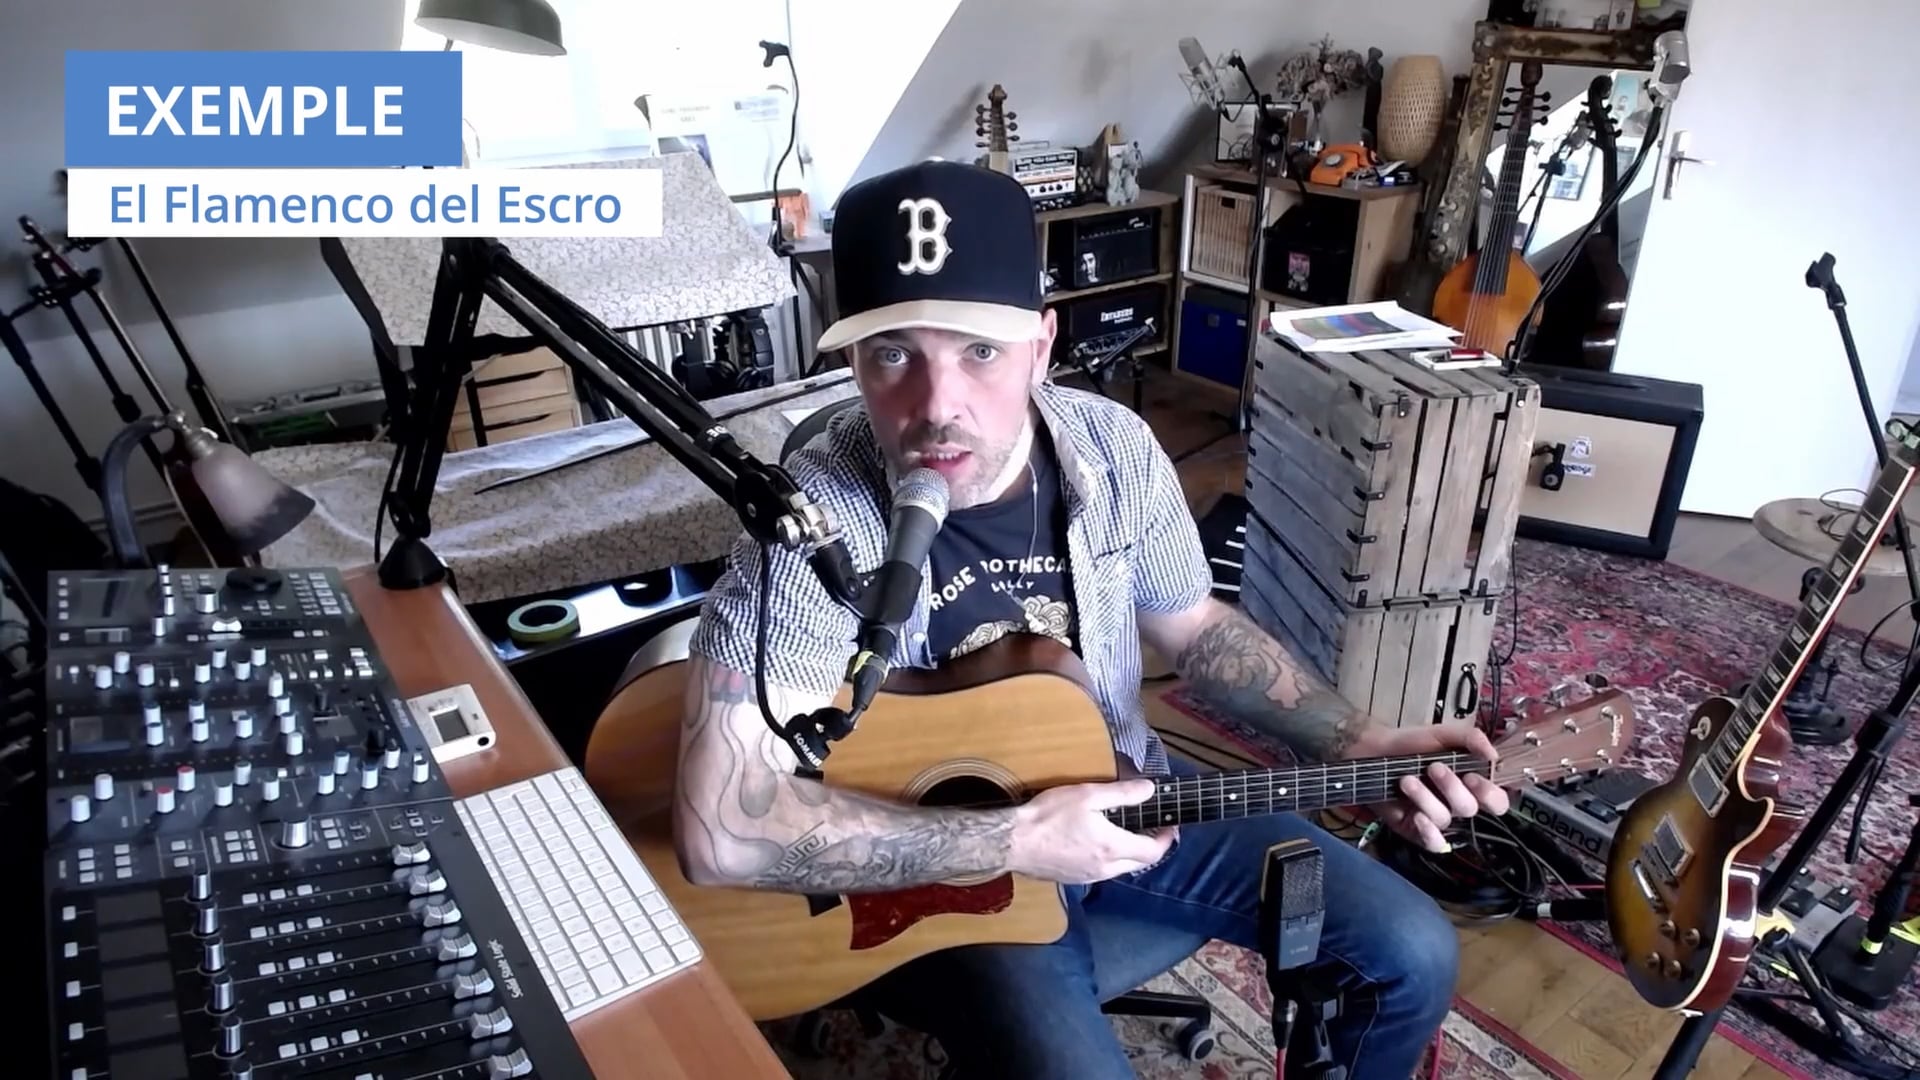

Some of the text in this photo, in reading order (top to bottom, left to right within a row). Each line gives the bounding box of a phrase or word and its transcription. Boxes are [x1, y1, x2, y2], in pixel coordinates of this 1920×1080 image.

[897, 197, 953, 275] B
[930, 566, 976, 611] ROSE
[1520, 796, 1603, 854] Roland
